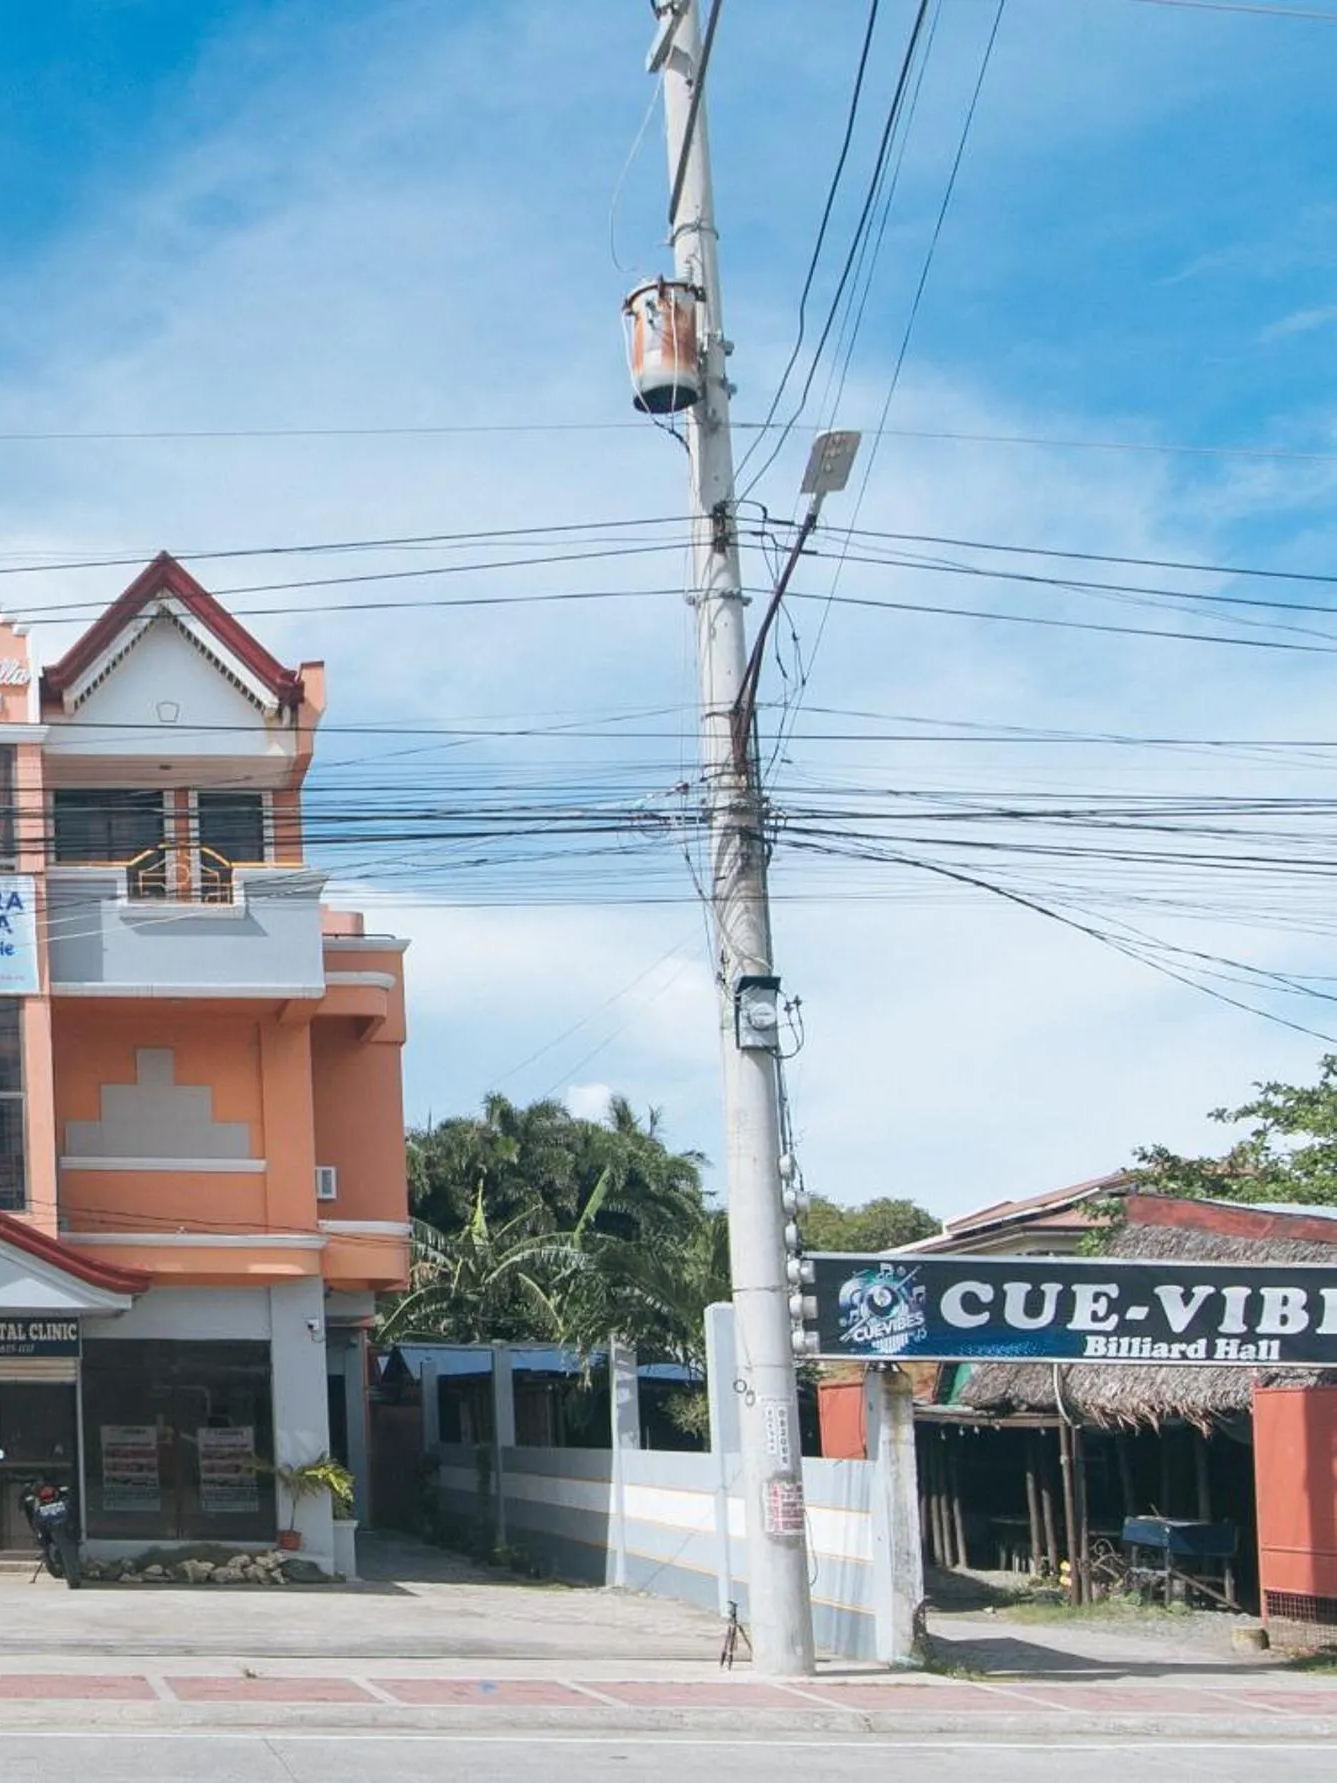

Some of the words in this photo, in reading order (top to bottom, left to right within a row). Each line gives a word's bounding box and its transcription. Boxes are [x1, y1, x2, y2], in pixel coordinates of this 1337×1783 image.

[29, 1322, 78, 1341] CLINIC
[852, 1309, 926, 1343] CUEVIBES
[1083, 1335, 1208, 1360] Billiard
[1213, 1338, 1281, 1361] Hall
